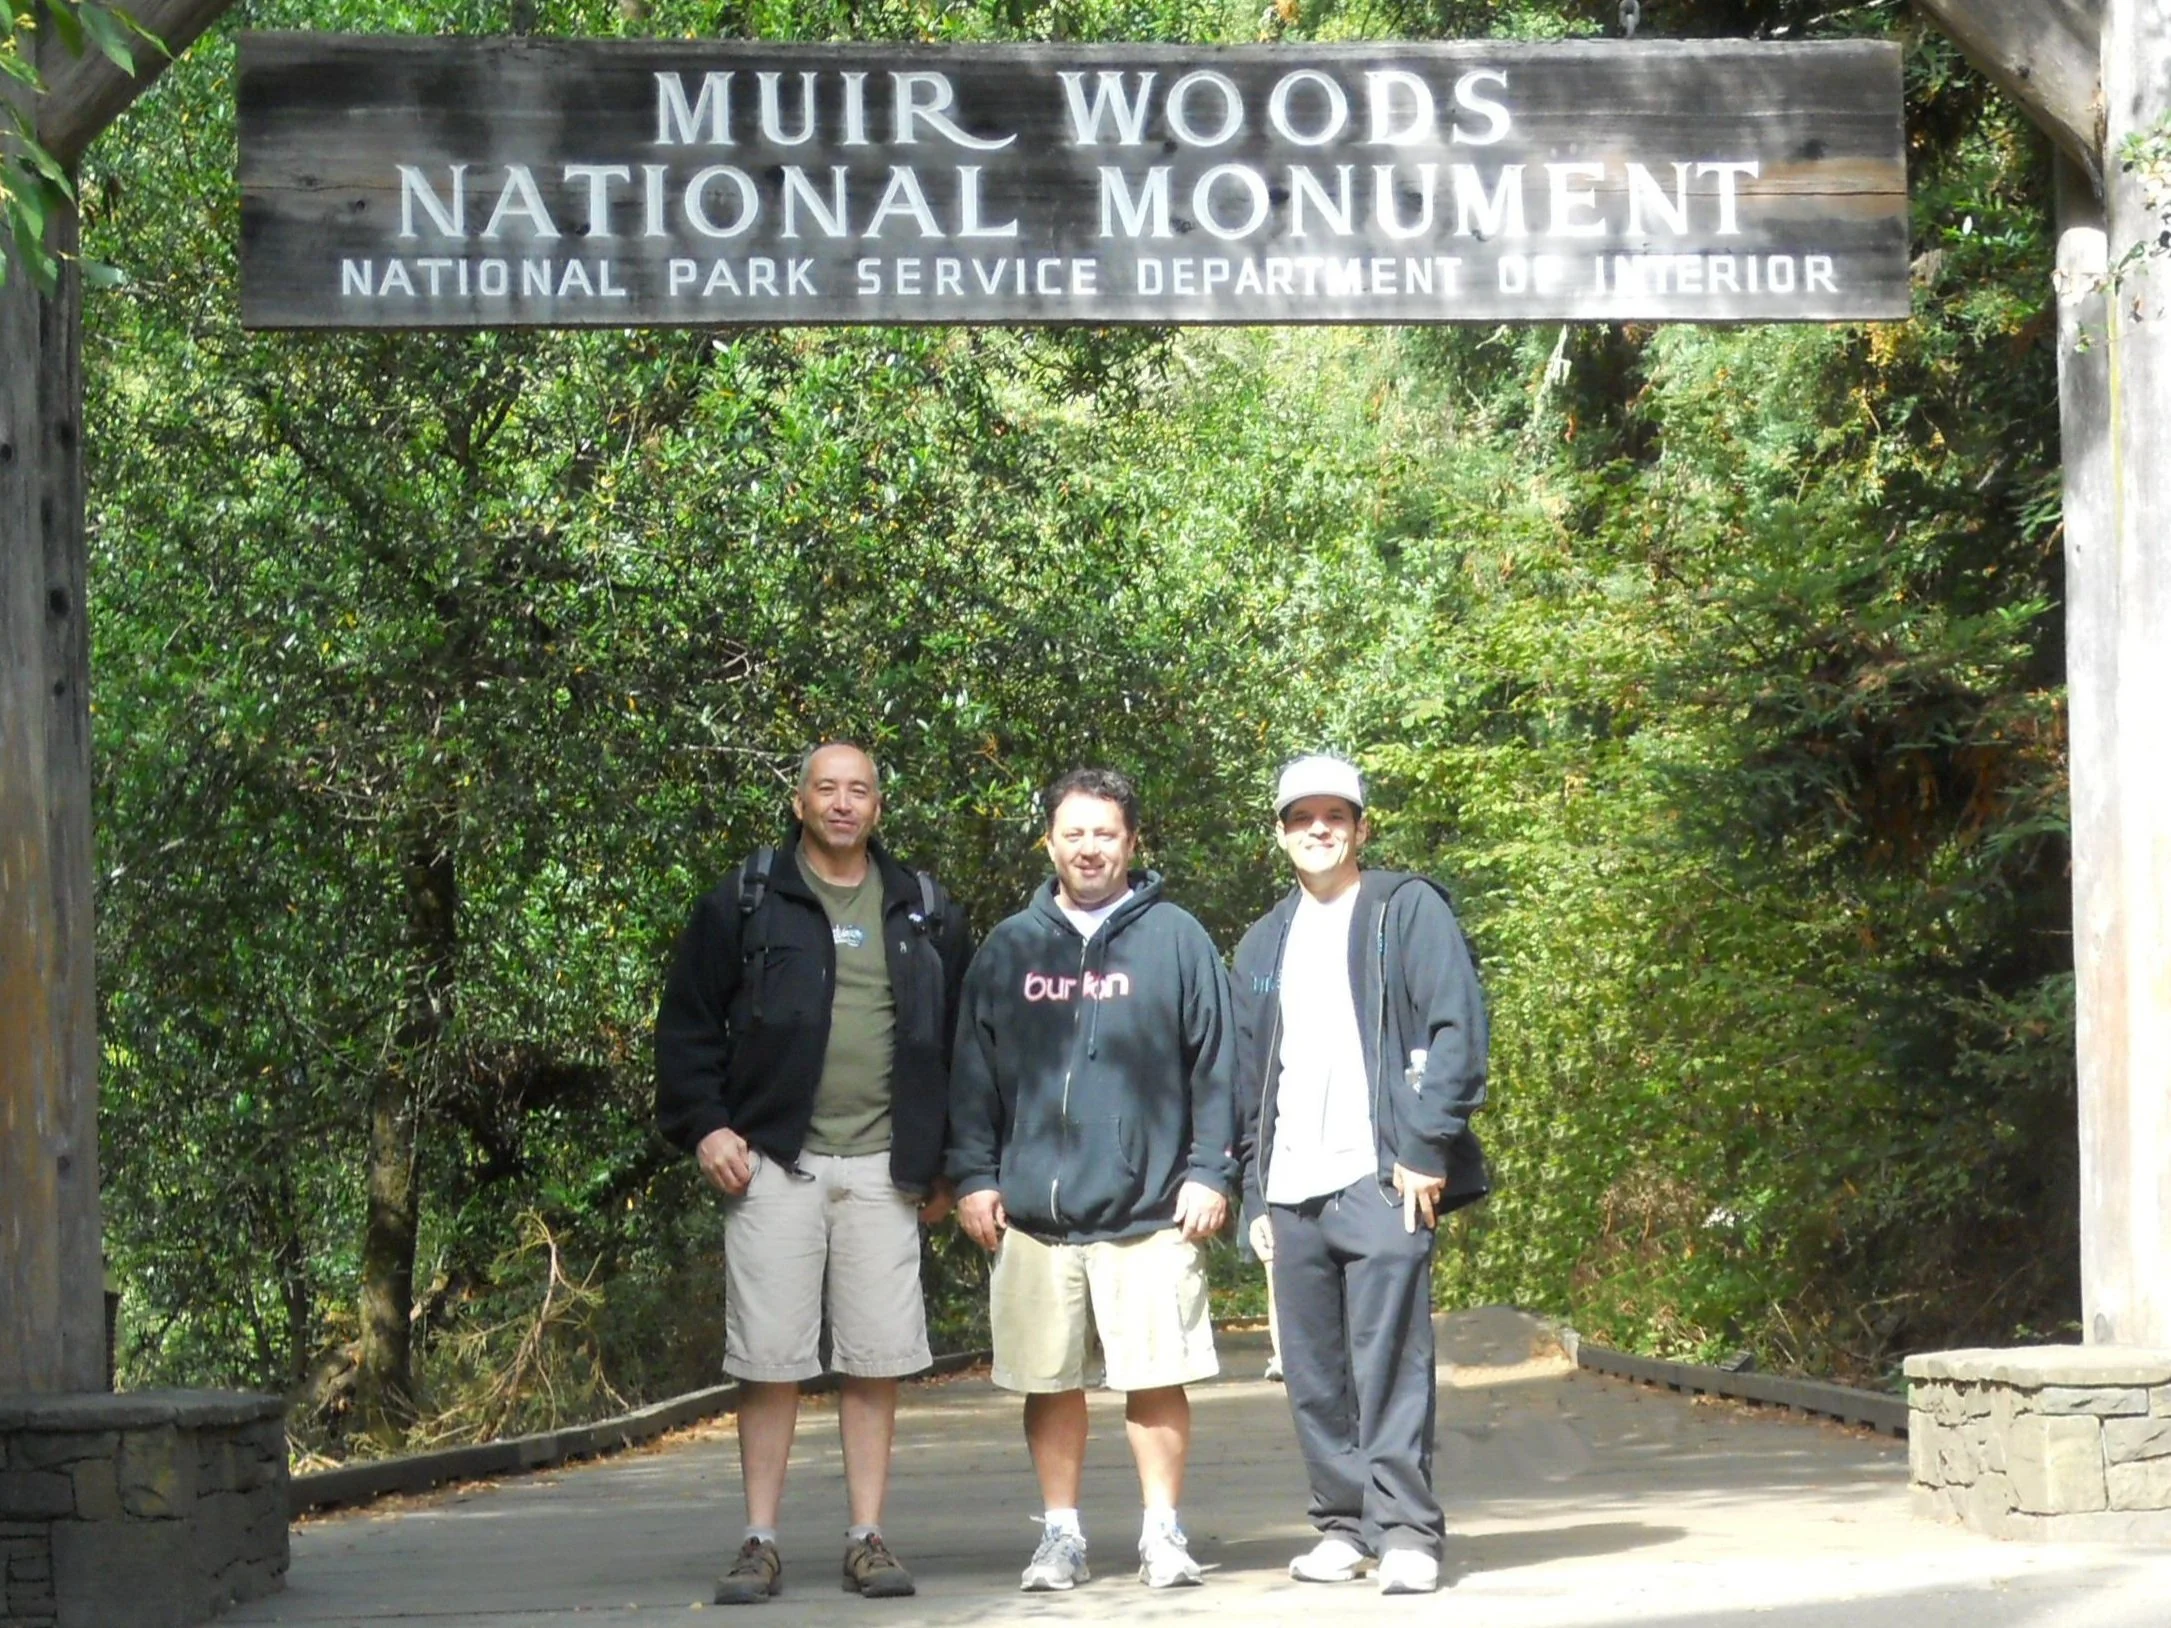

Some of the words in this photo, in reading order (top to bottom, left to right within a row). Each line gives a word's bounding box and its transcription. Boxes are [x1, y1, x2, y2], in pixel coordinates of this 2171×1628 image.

[653, 71, 1018, 150] MUIR
[1056, 69, 1511, 147] WOODS
[397, 163, 1019, 239] NATIONAL
[1098, 160, 1761, 240] MONUMENT
[341, 258, 627, 297] NATIONAL
[668, 257, 818, 296] PARK
[856, 257, 1097, 296] SERVICE
[1136, 256, 1463, 296] DEPARTMENT
[1595, 254, 1838, 295] INTERIOR
